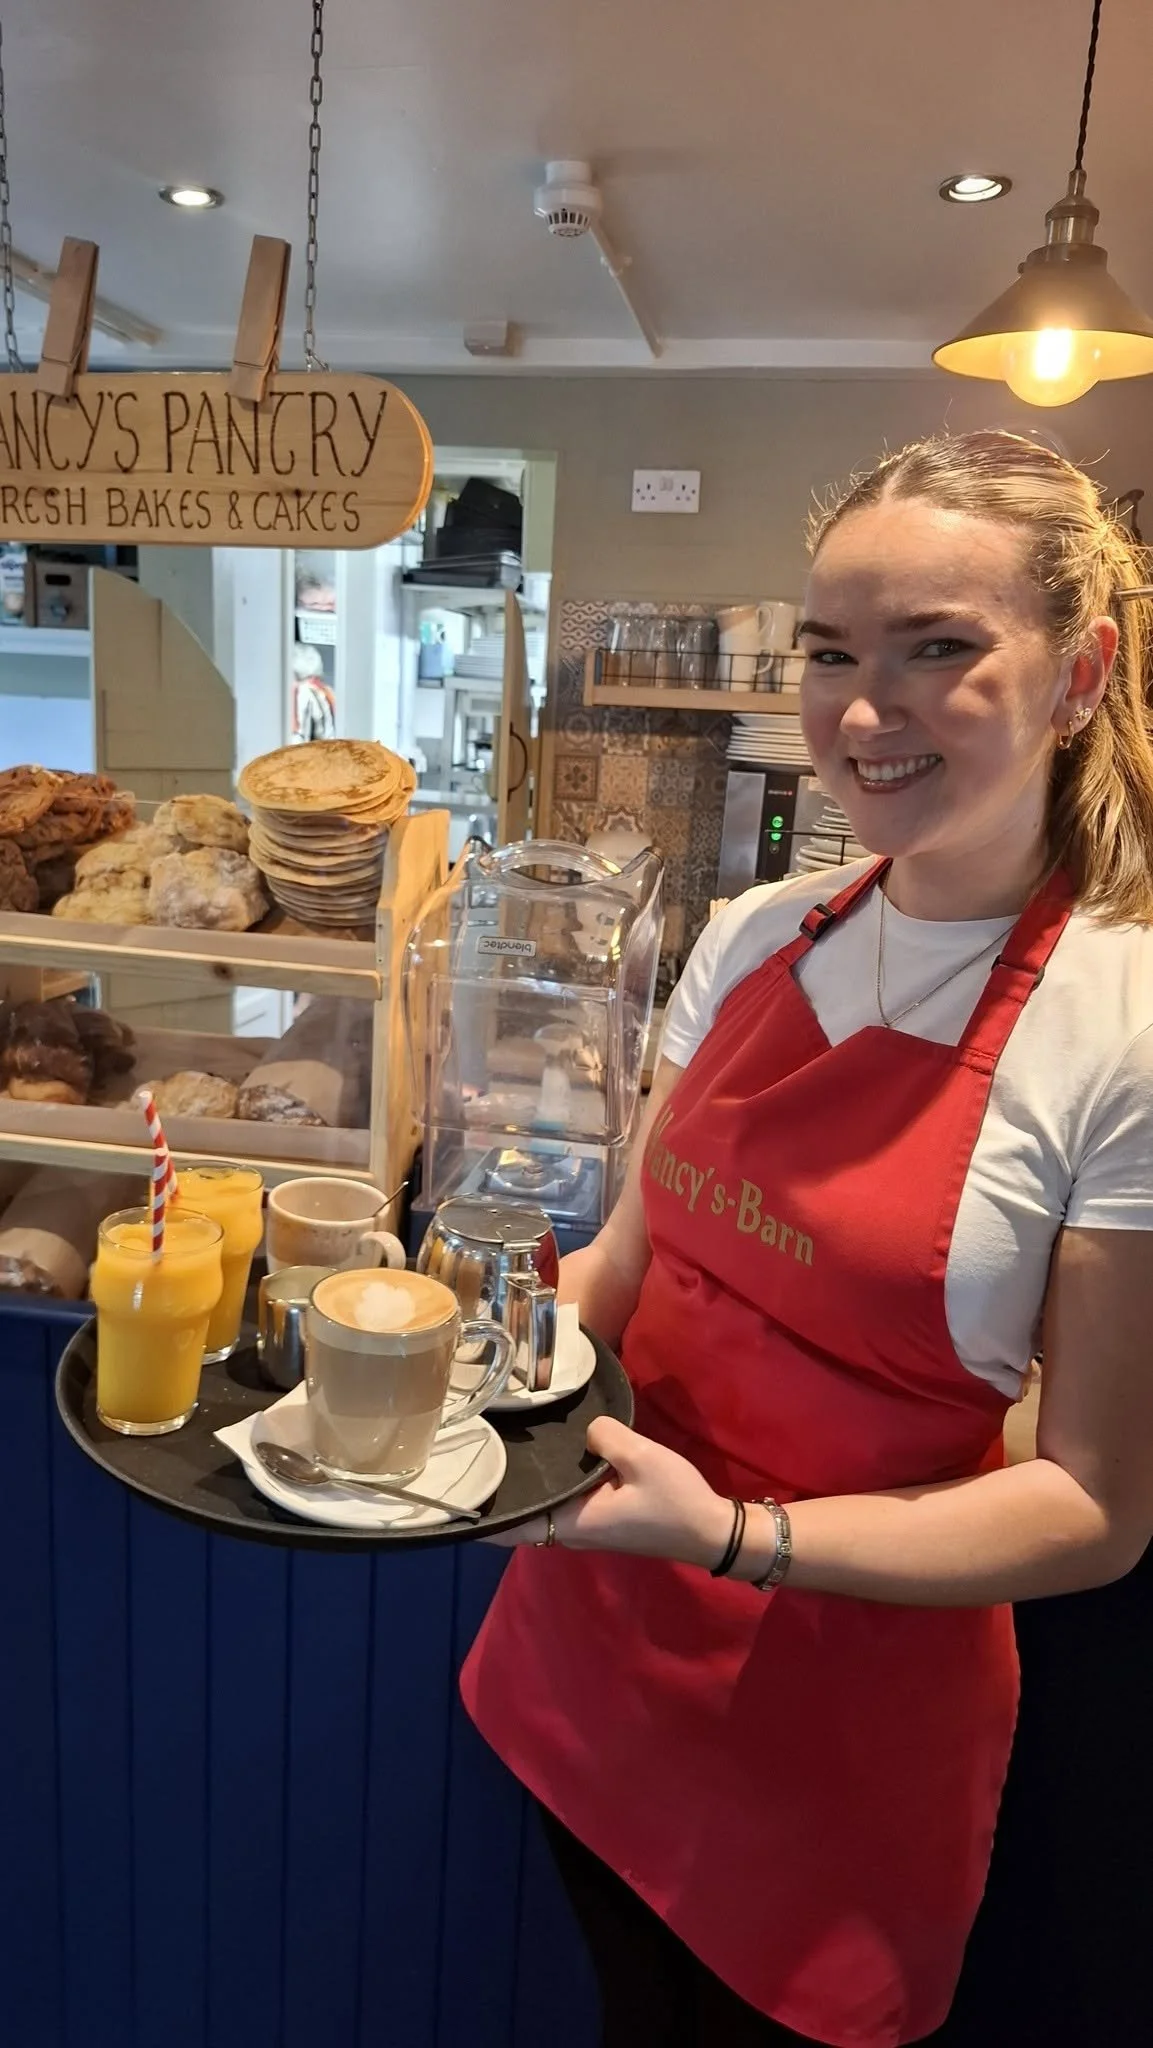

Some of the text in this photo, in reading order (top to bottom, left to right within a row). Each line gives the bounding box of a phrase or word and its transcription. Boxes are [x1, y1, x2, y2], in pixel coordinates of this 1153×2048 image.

[163, 391, 388, 476] PANTRY
[106, 487, 212, 528] BAKES
[227, 488, 244, 530] &
[253, 490, 361, 532] CAKES
[484, 940, 532, 952] blendtec
